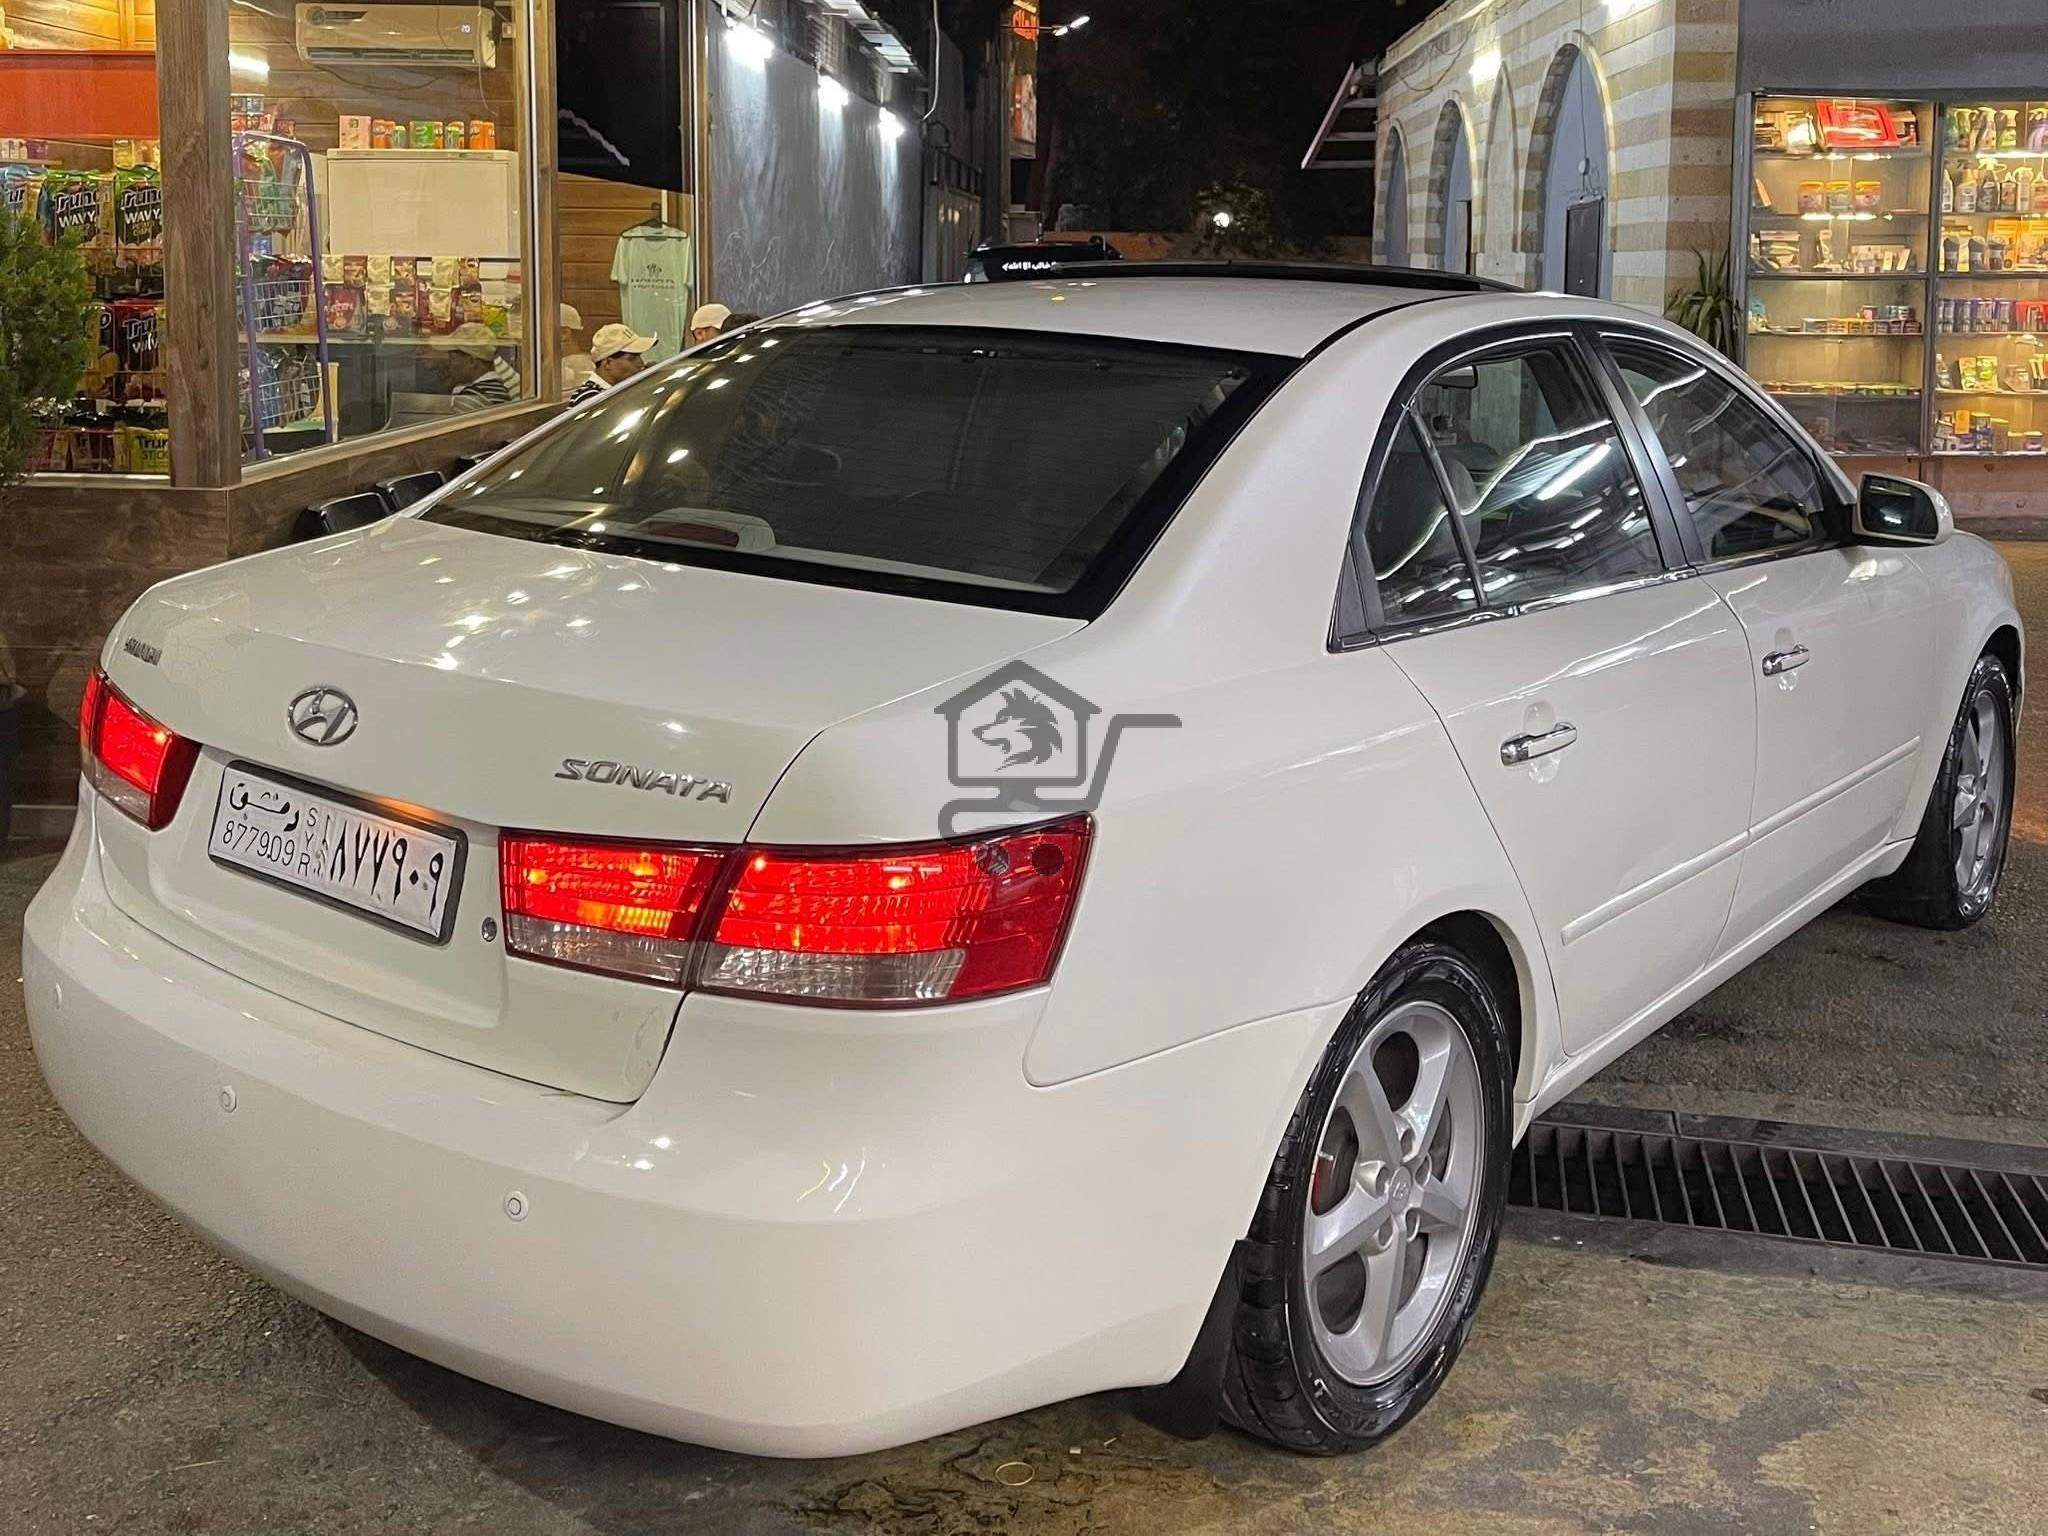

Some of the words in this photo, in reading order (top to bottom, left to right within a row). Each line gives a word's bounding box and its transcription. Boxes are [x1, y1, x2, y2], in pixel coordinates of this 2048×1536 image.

[58, 211, 96, 228] WAVY
[125, 208, 160, 224] WAVY
[555, 758, 732, 804] SONATA
[229, 782, 300, 832] دمشق
[222, 819, 296, 867] 877909
[329, 819, 444, 920] ٨٧٧٩٠٩
